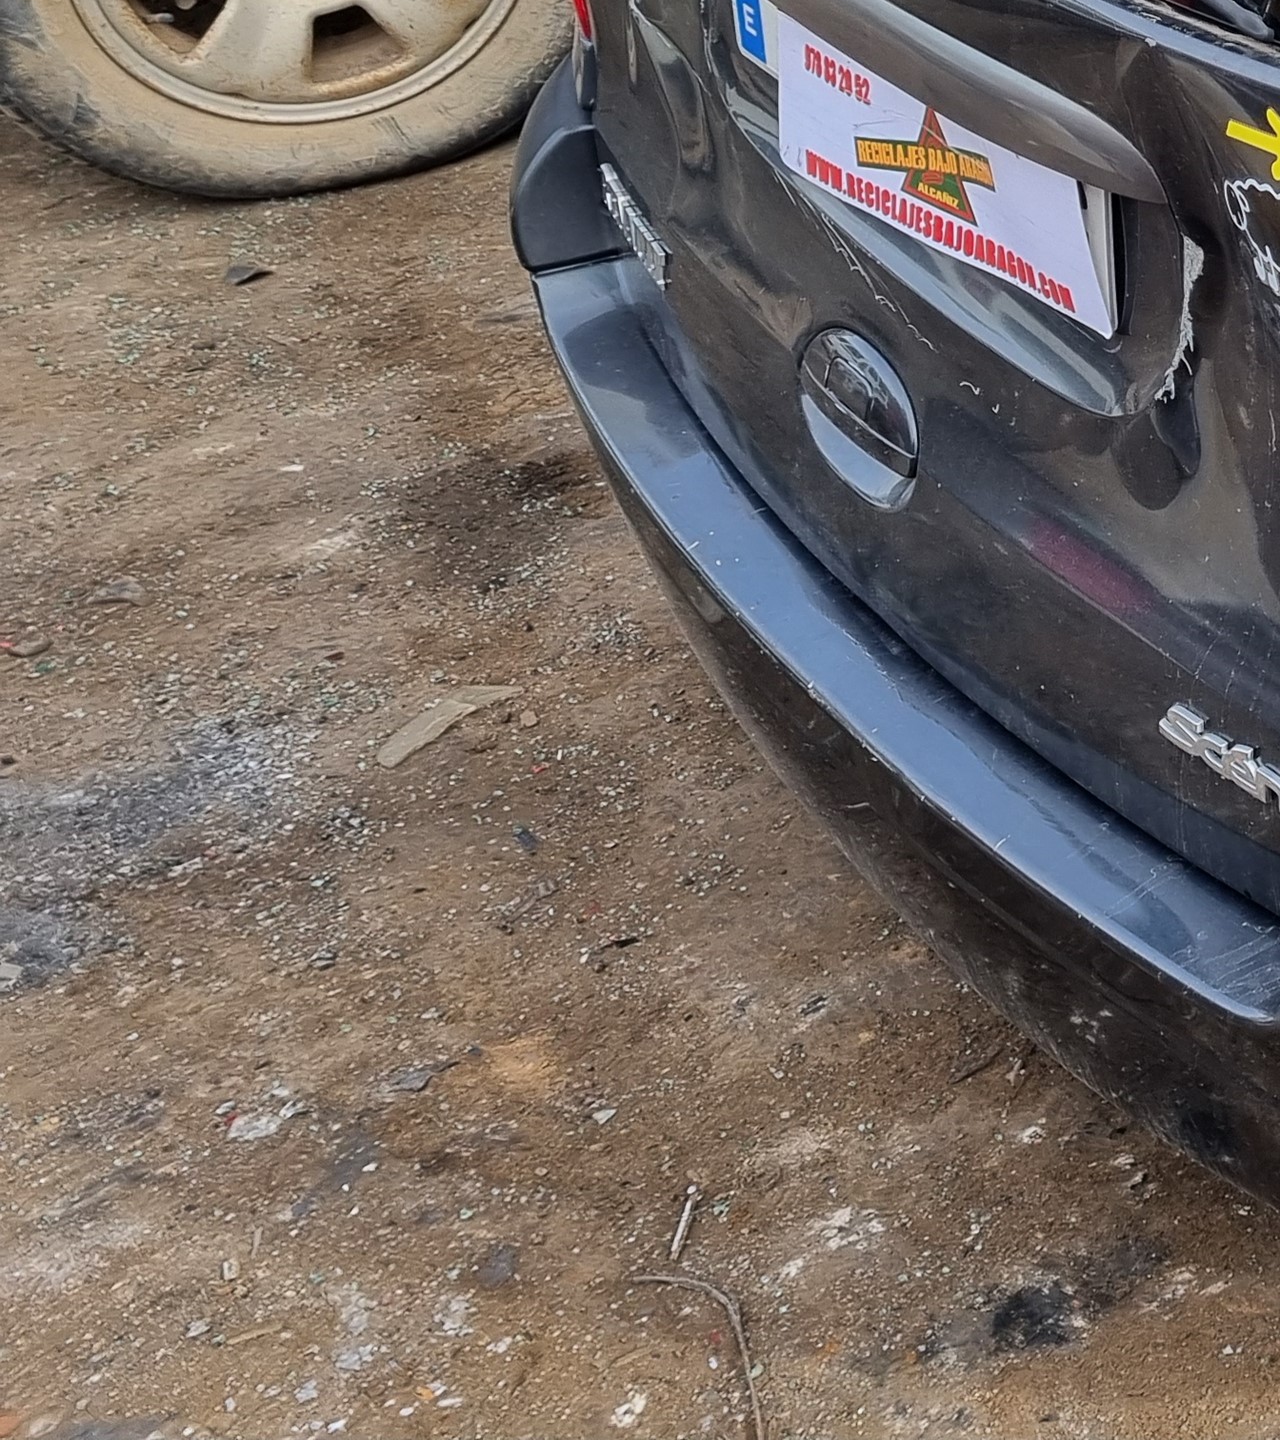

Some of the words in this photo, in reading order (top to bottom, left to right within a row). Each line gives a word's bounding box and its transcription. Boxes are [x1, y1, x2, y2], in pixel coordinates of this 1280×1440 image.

[742, 2, 757, 37] E
[857, 140, 926, 170] RECICLAJES
[927, 147, 958, 175] BAJO
[805, 148, 1077, 314] WWW.RECICLAJESBAJOARAGON.COM
